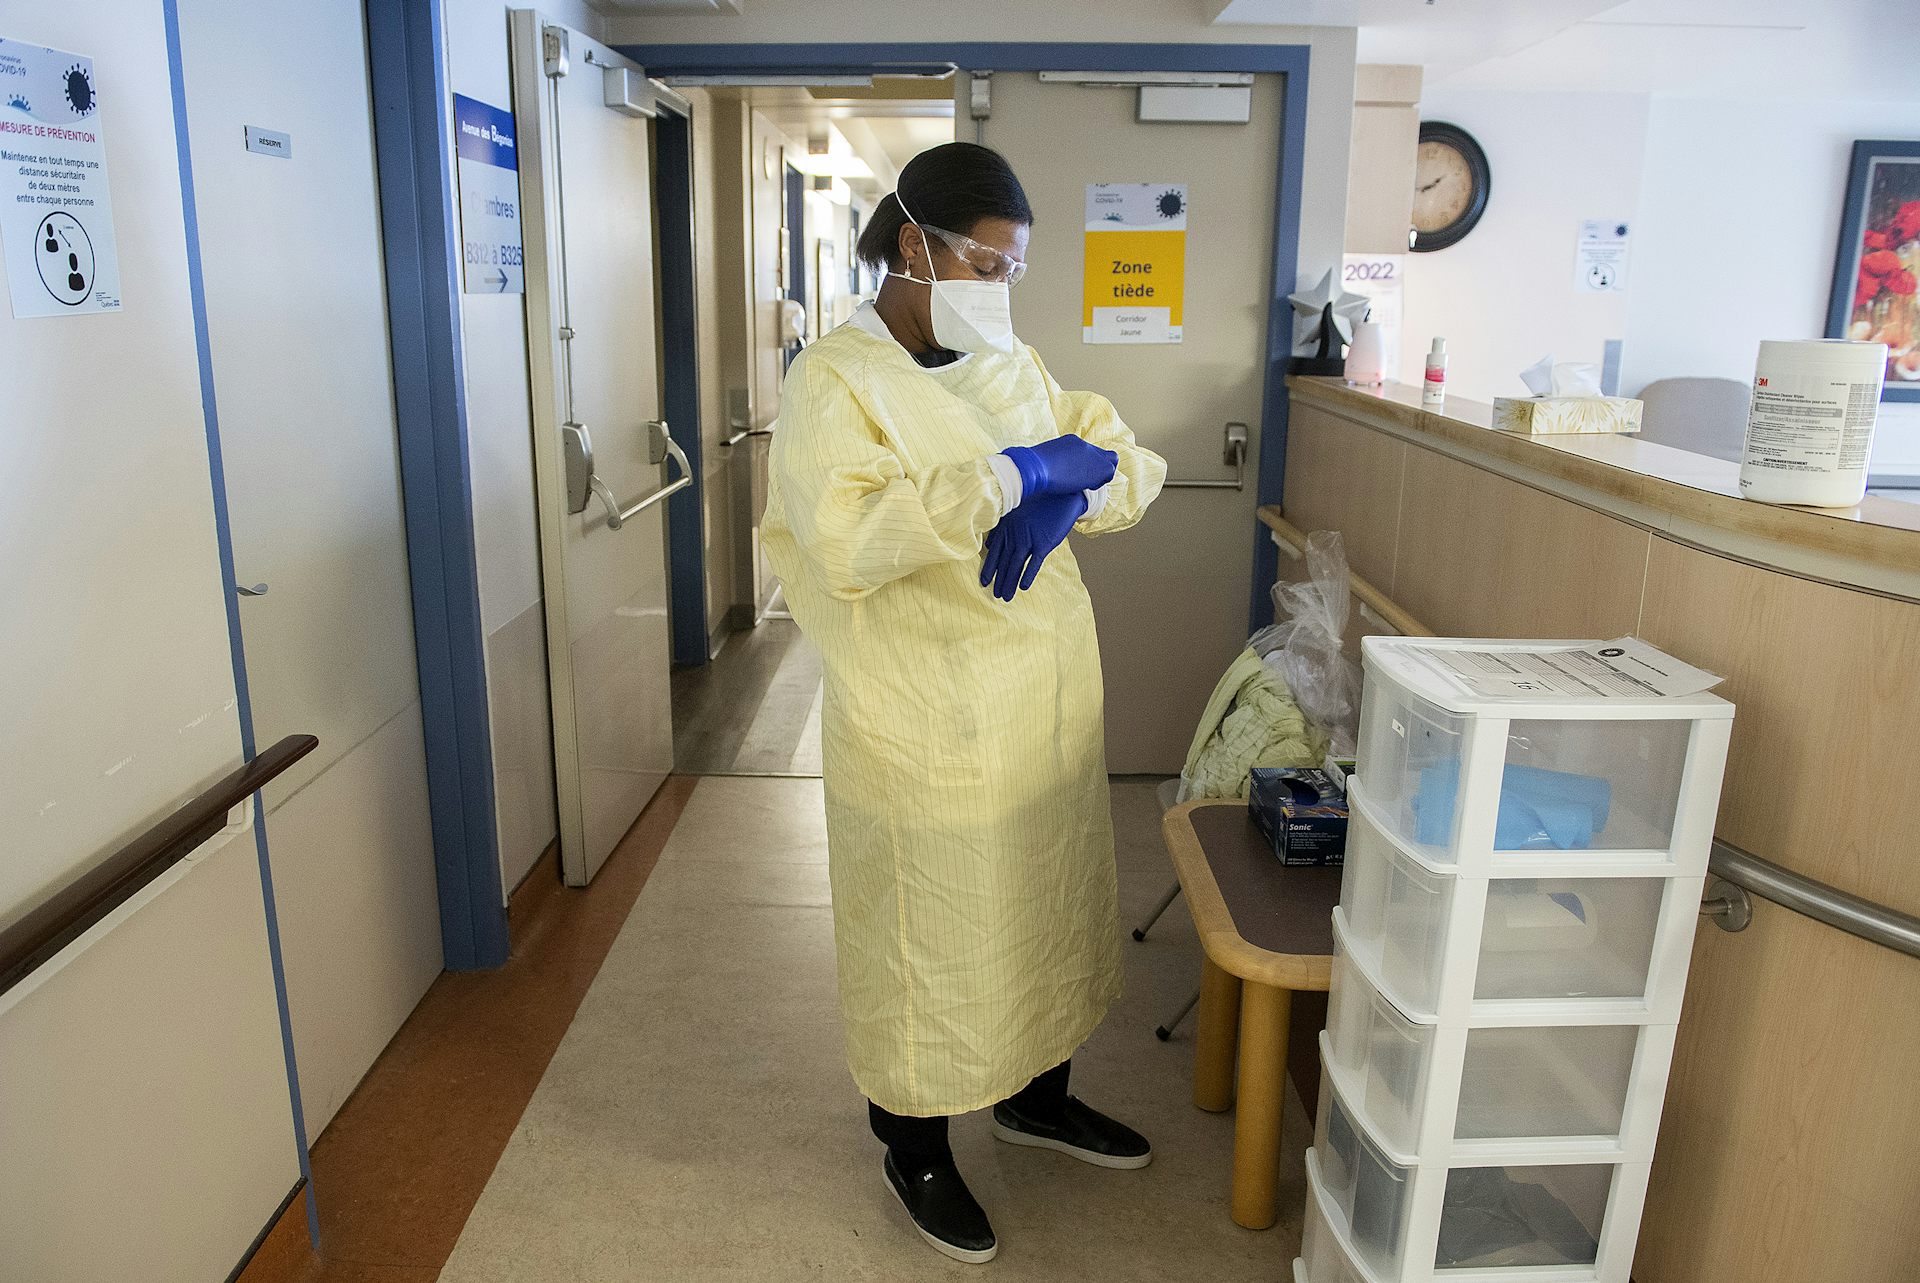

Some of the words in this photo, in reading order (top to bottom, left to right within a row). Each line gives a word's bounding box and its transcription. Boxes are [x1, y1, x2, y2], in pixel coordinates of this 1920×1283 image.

[0, 63, 26, 77] OVID-19
[34, 126, 46, 137] DE
[47, 127, 96, 143] PRÉVENTION
[481, 127, 490, 140] des
[1, 150, 37, 163] Maintenez
[38, 156, 48, 164] en
[49, 156, 62, 166] tout
[64, 157, 85, 169] temps
[86, 161, 99, 169] une
[19, 166, 48, 177] distance
[50, 169, 86, 180] sécuritaire
[28, 181, 37, 190] de
[38, 181, 55, 191] deux
[57, 183, 80, 193] mètres
[16, 194, 35, 203] entre
[36, 194, 62, 206] chaque
[63, 198, 95, 207] personne
[471, 191, 514, 219] Cambres
[466, 242, 489, 265] B312
[492, 243, 498, 265] à
[501, 245, 523, 266] B325
[1112, 261, 1153, 275] Zone
[1345, 262, 1394, 281] 2022
[1113, 284, 1155, 298] tiède
[1115, 315, 1147, 324] Corridor
[1119, 328, 1142, 337] Jaune
[1758, 377, 1768, 387] 3M
